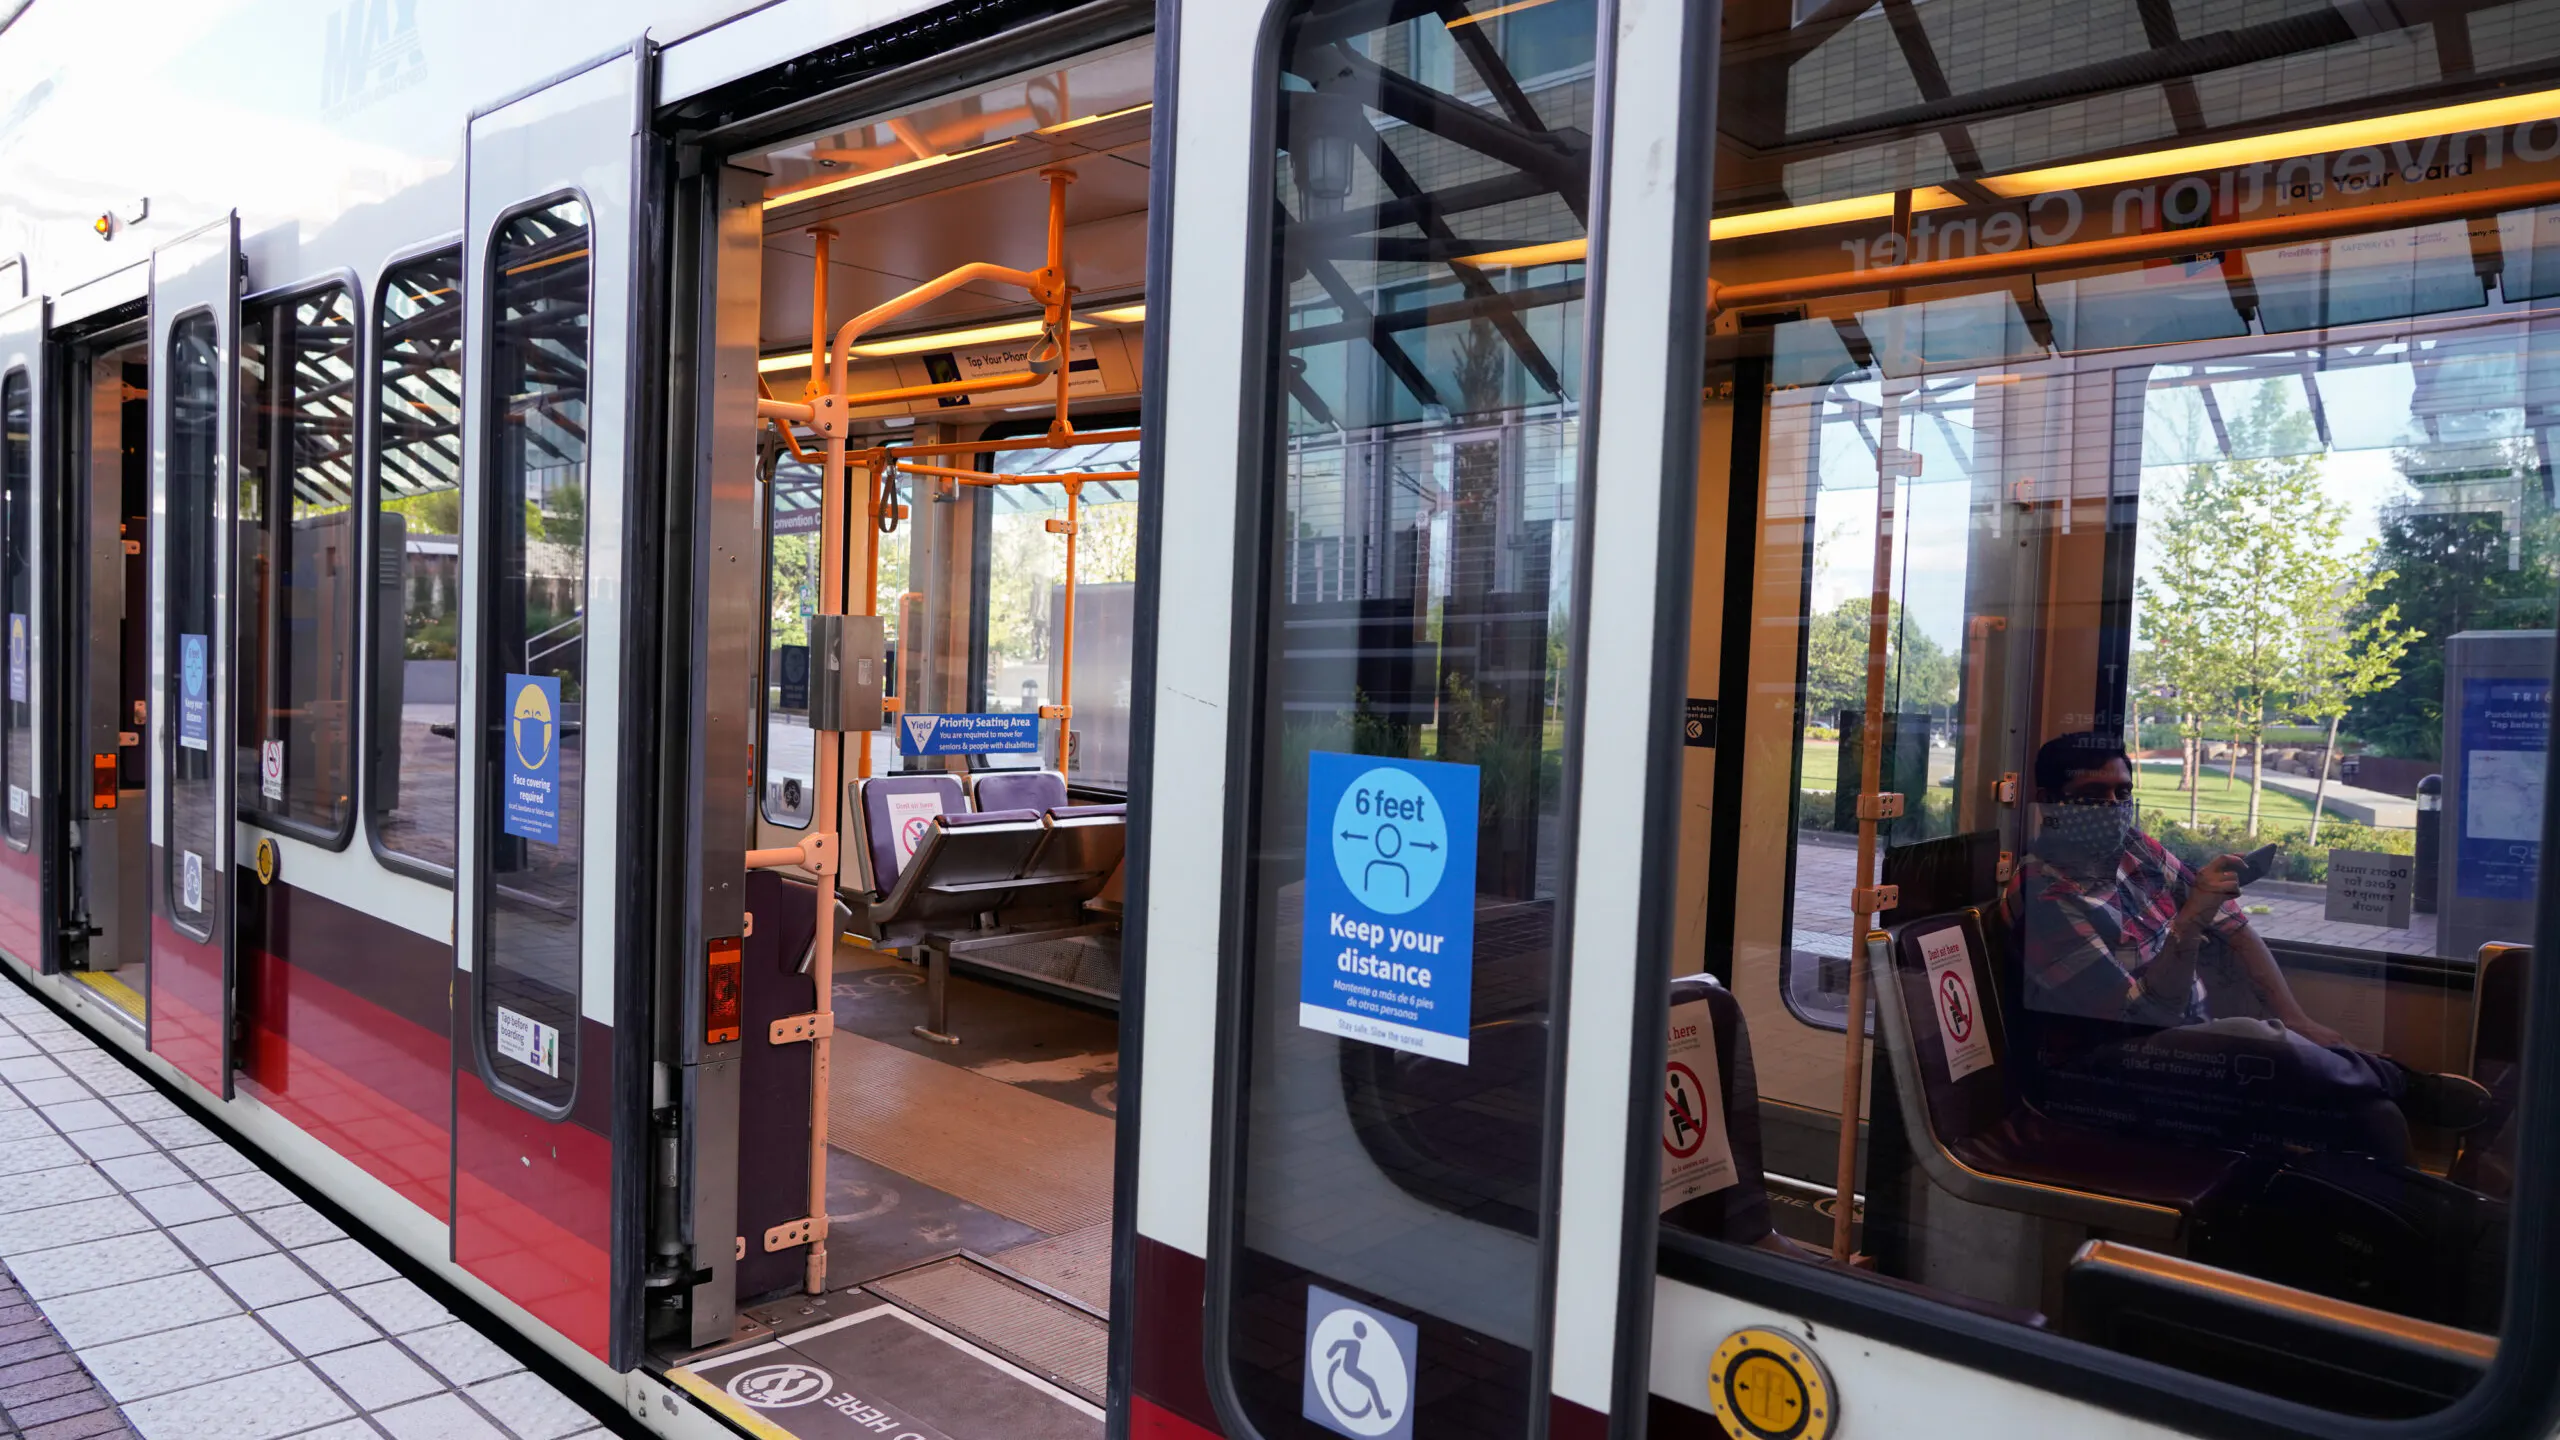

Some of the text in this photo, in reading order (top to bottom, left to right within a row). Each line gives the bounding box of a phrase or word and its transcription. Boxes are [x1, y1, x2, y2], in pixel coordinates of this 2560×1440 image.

[2280, 153, 2473, 202] Tap Your Card
[966, 356, 983, 368] Tap
[983, 354, 1003, 365] Your
[910, 721, 932, 730] Yield
[939, 717, 1031, 730] Priority Seating Area
[962, 742, 968, 750] &
[969, 742, 990, 751] people
[990, 741, 1004, 749] with
[1004, 741, 1035, 749] disabilities
[963, 731, 989, 740] required
[1014, 730, 1023, 738] for
[513, 773, 551, 793] Face covering
[519, 790, 544, 804] required
[1355, 788, 1425, 822] 6 feet
[1330, 912, 1444, 955] Keep your
[1337, 948, 1432, 988] distance
[1333, 979, 1434, 1010] Mantente a más de 6 pies
[1346, 997, 1419, 1021] de otras personas
[501, 1012, 529, 1033] Tap before
[1339, 1018, 1352, 1031] Stay
[1370, 1026, 1386, 1038] Slow
[1387, 1030, 1399, 1042] the
[1672, 1025, 1697, 1040] here
[500, 1024, 525, 1047] boarding
[823, 1391, 900, 1434] HERE
